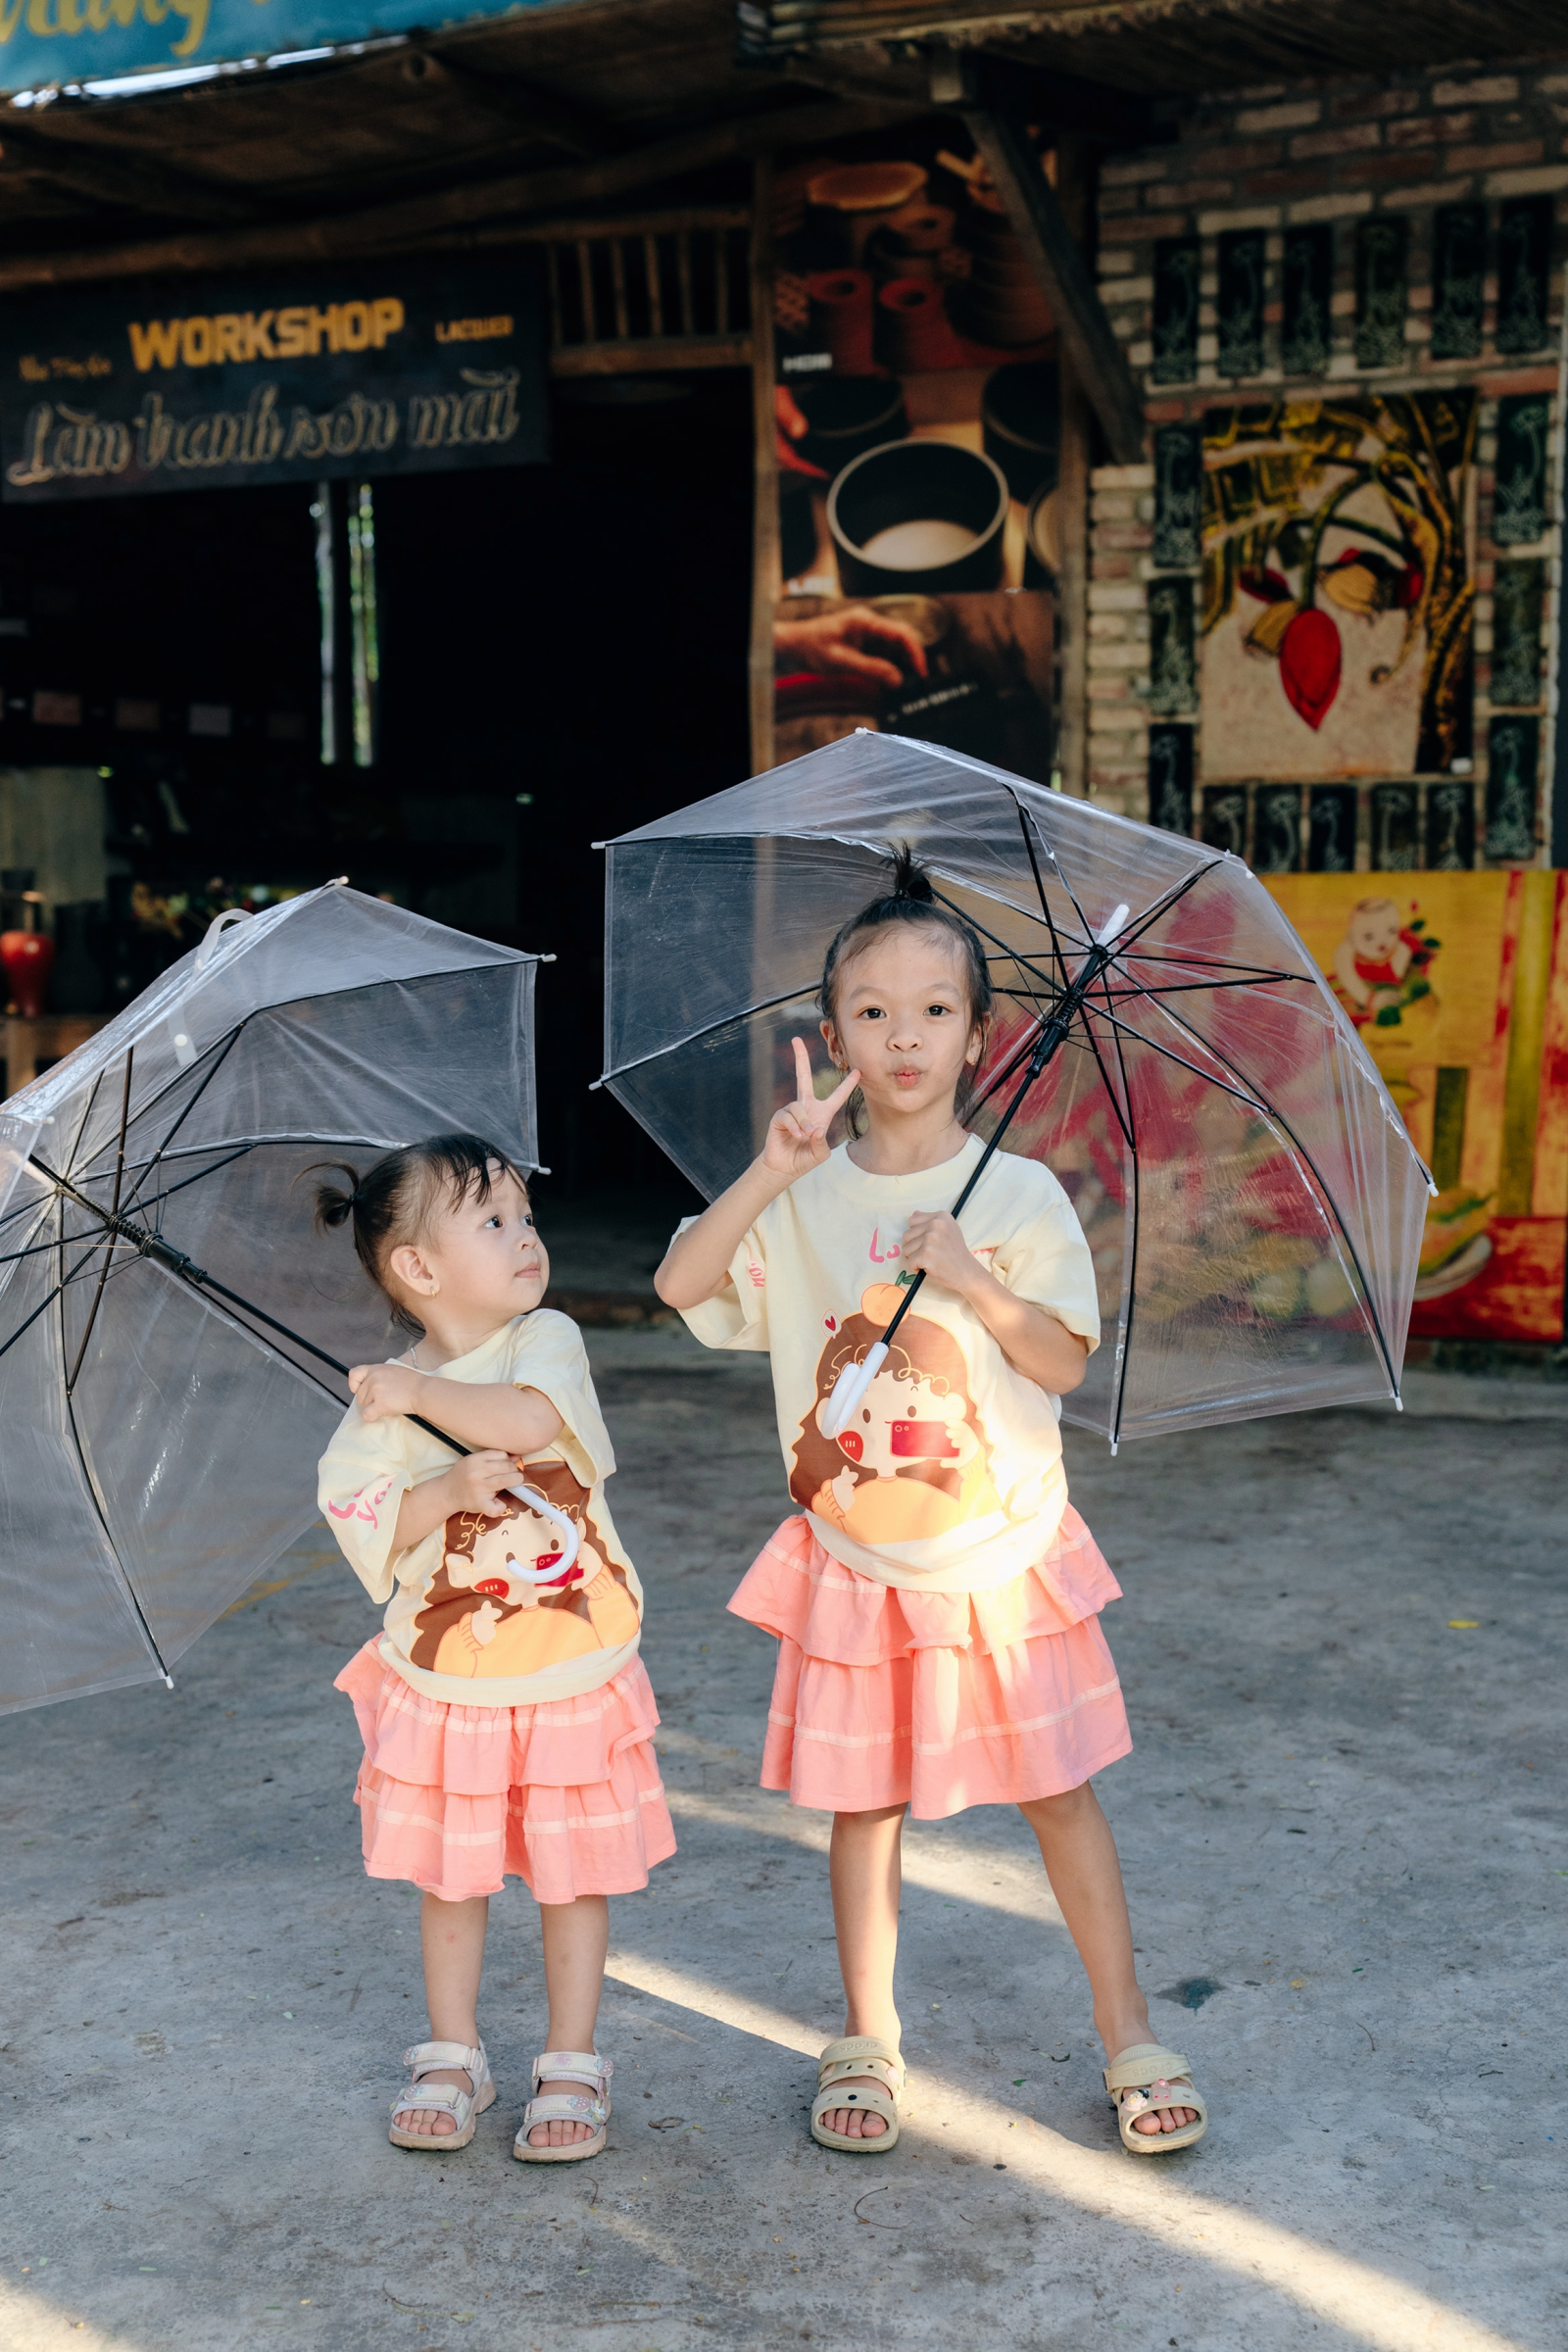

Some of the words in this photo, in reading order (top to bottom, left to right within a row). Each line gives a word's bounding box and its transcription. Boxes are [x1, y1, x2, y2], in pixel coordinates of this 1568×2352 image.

[128, 297, 405, 372] WORKSHOP
[840, 2041, 878, 2052] crocs
[1132, 2061, 1173, 2078] crocs
